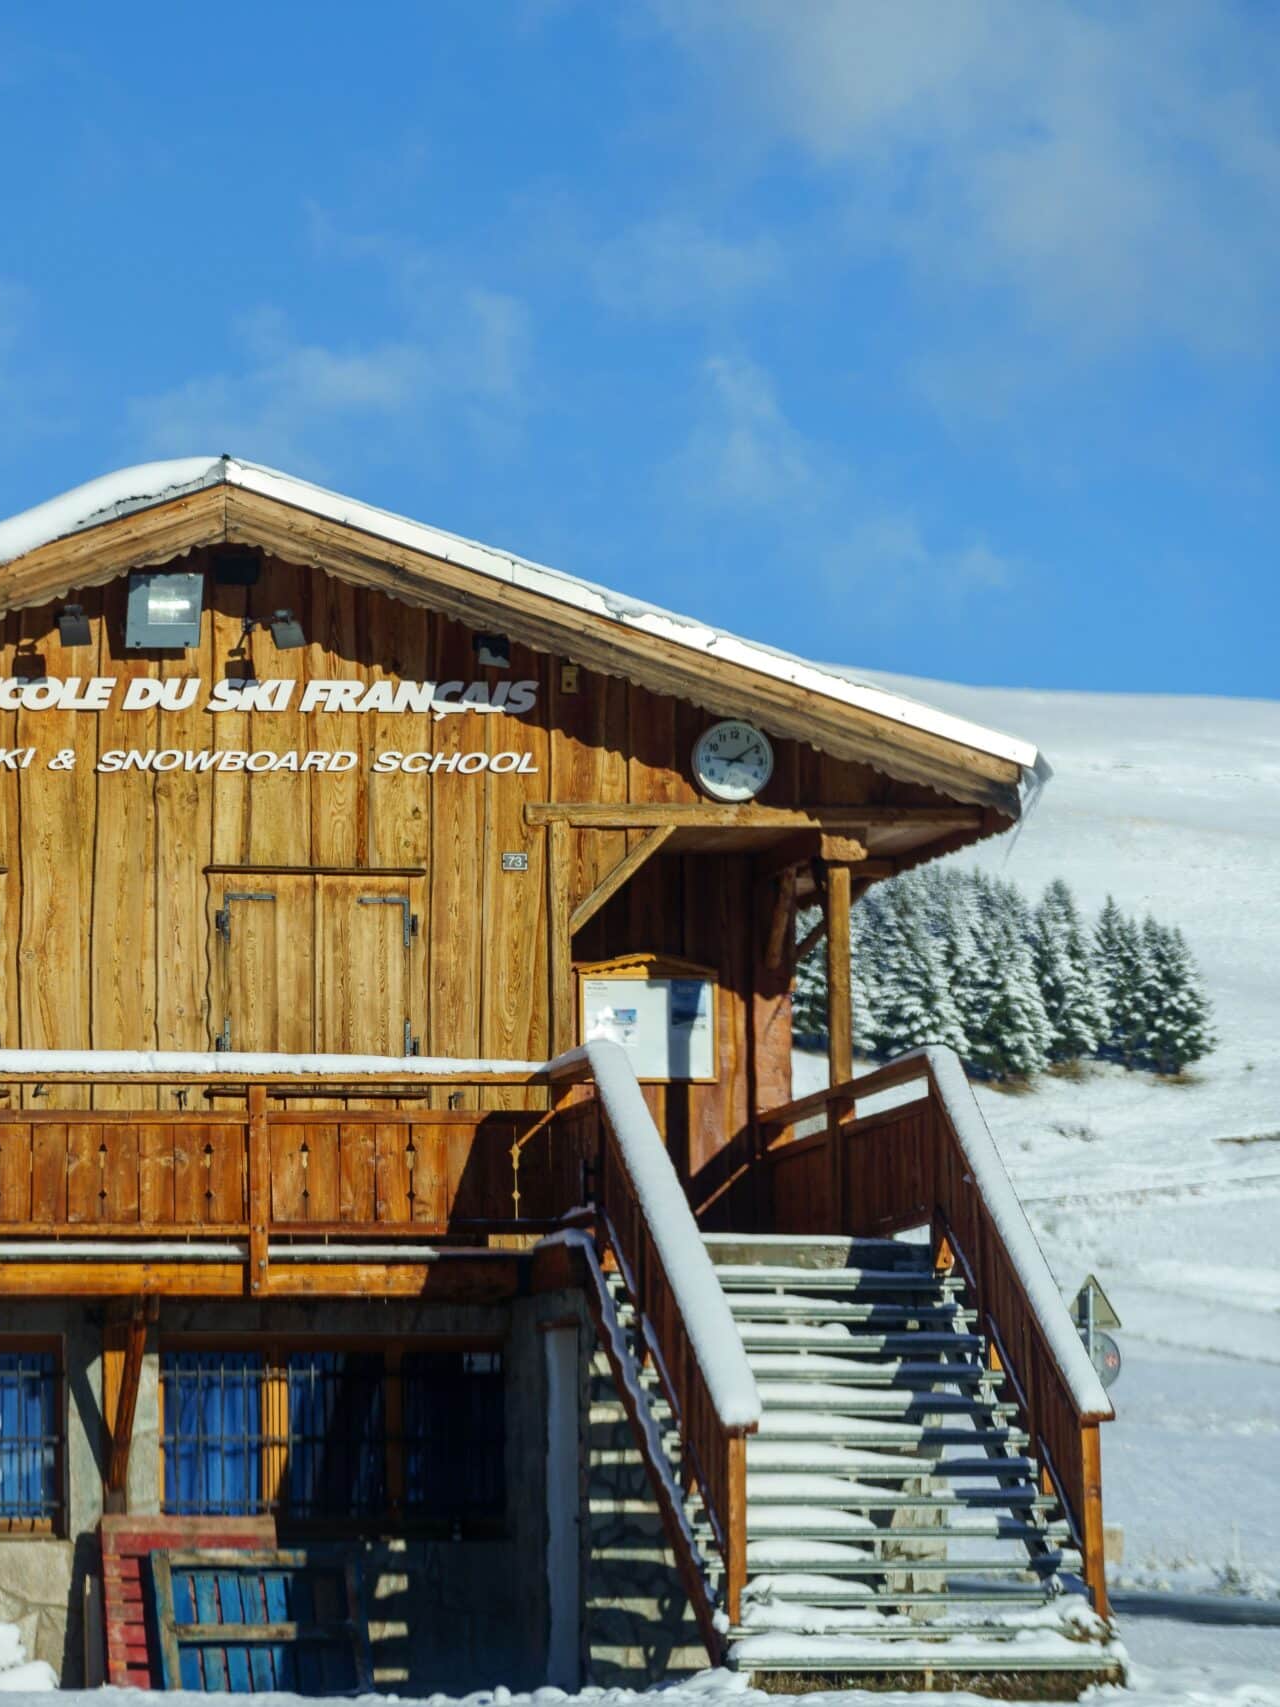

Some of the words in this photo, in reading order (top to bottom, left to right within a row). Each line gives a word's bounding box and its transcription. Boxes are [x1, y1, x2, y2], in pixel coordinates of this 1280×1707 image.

[121, 677, 202, 711] DU
[206, 678, 296, 713] SKI
[298, 679, 539, 721] FRANÇAIS
[48, 748, 77, 770] &
[96, 750, 359, 773] SNOWBOARD
[372, 751, 539, 774] SCHOOL
[508, 856, 522, 867] 73
